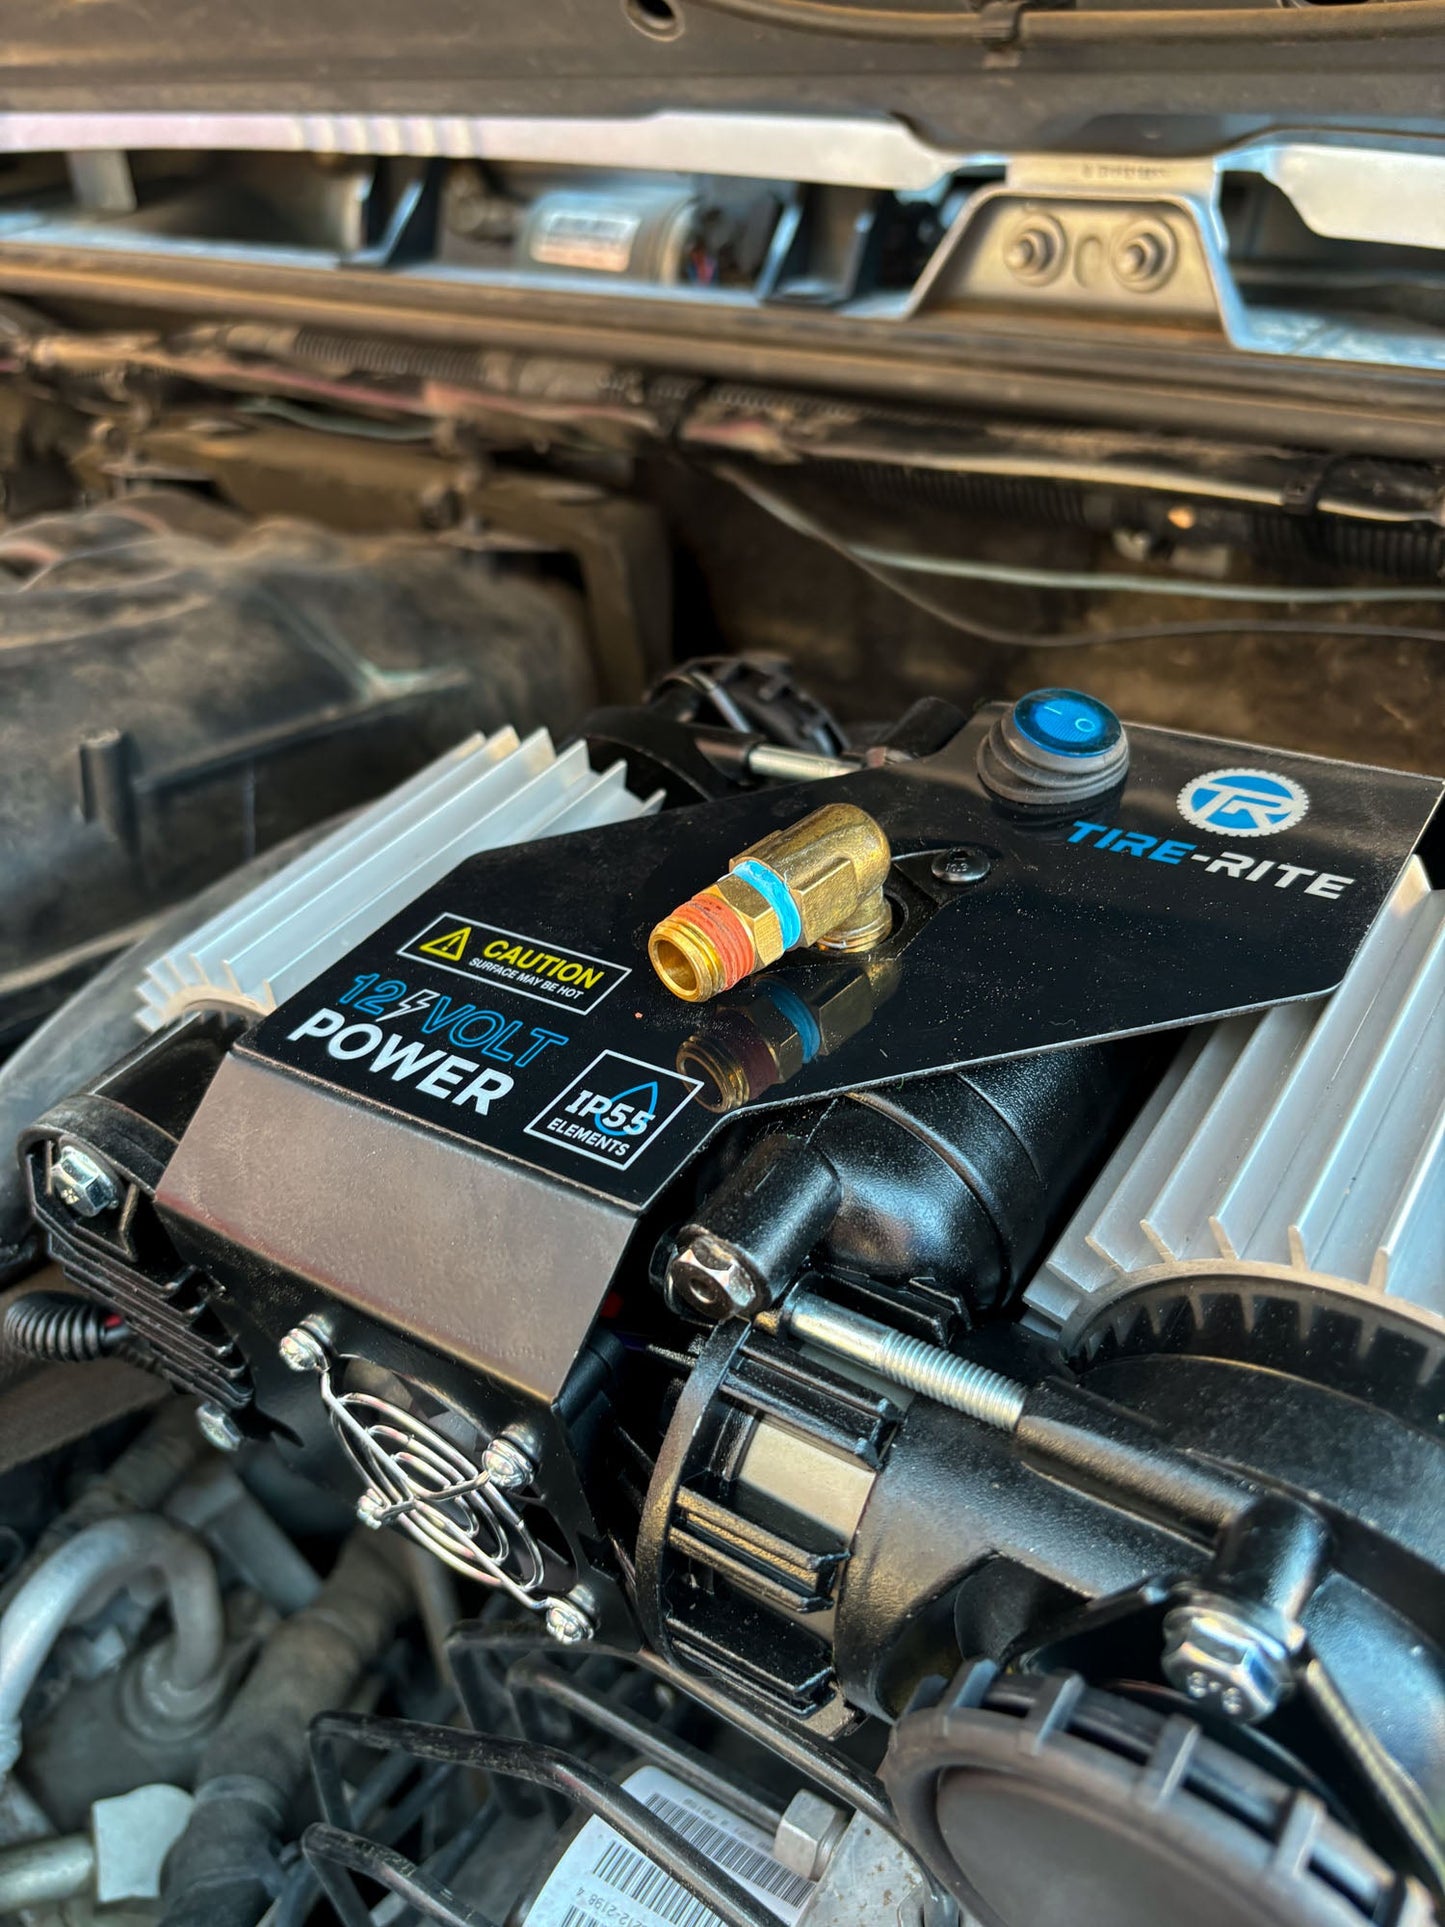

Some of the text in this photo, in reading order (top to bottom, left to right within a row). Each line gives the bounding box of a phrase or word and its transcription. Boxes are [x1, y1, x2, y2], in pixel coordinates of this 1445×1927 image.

[1066, 820, 1355, 900] TIRE-RITE
[468, 957, 585, 1000] SURFACE MAY BE HOT
[483, 940, 604, 989] CAUTION
[338, 972, 569, 1068] 12 VOLT
[287, 1008, 515, 1116] POWER
[546, 1117, 631, 1157] ELEMENTS
[564, 1089, 656, 1136] IP55
